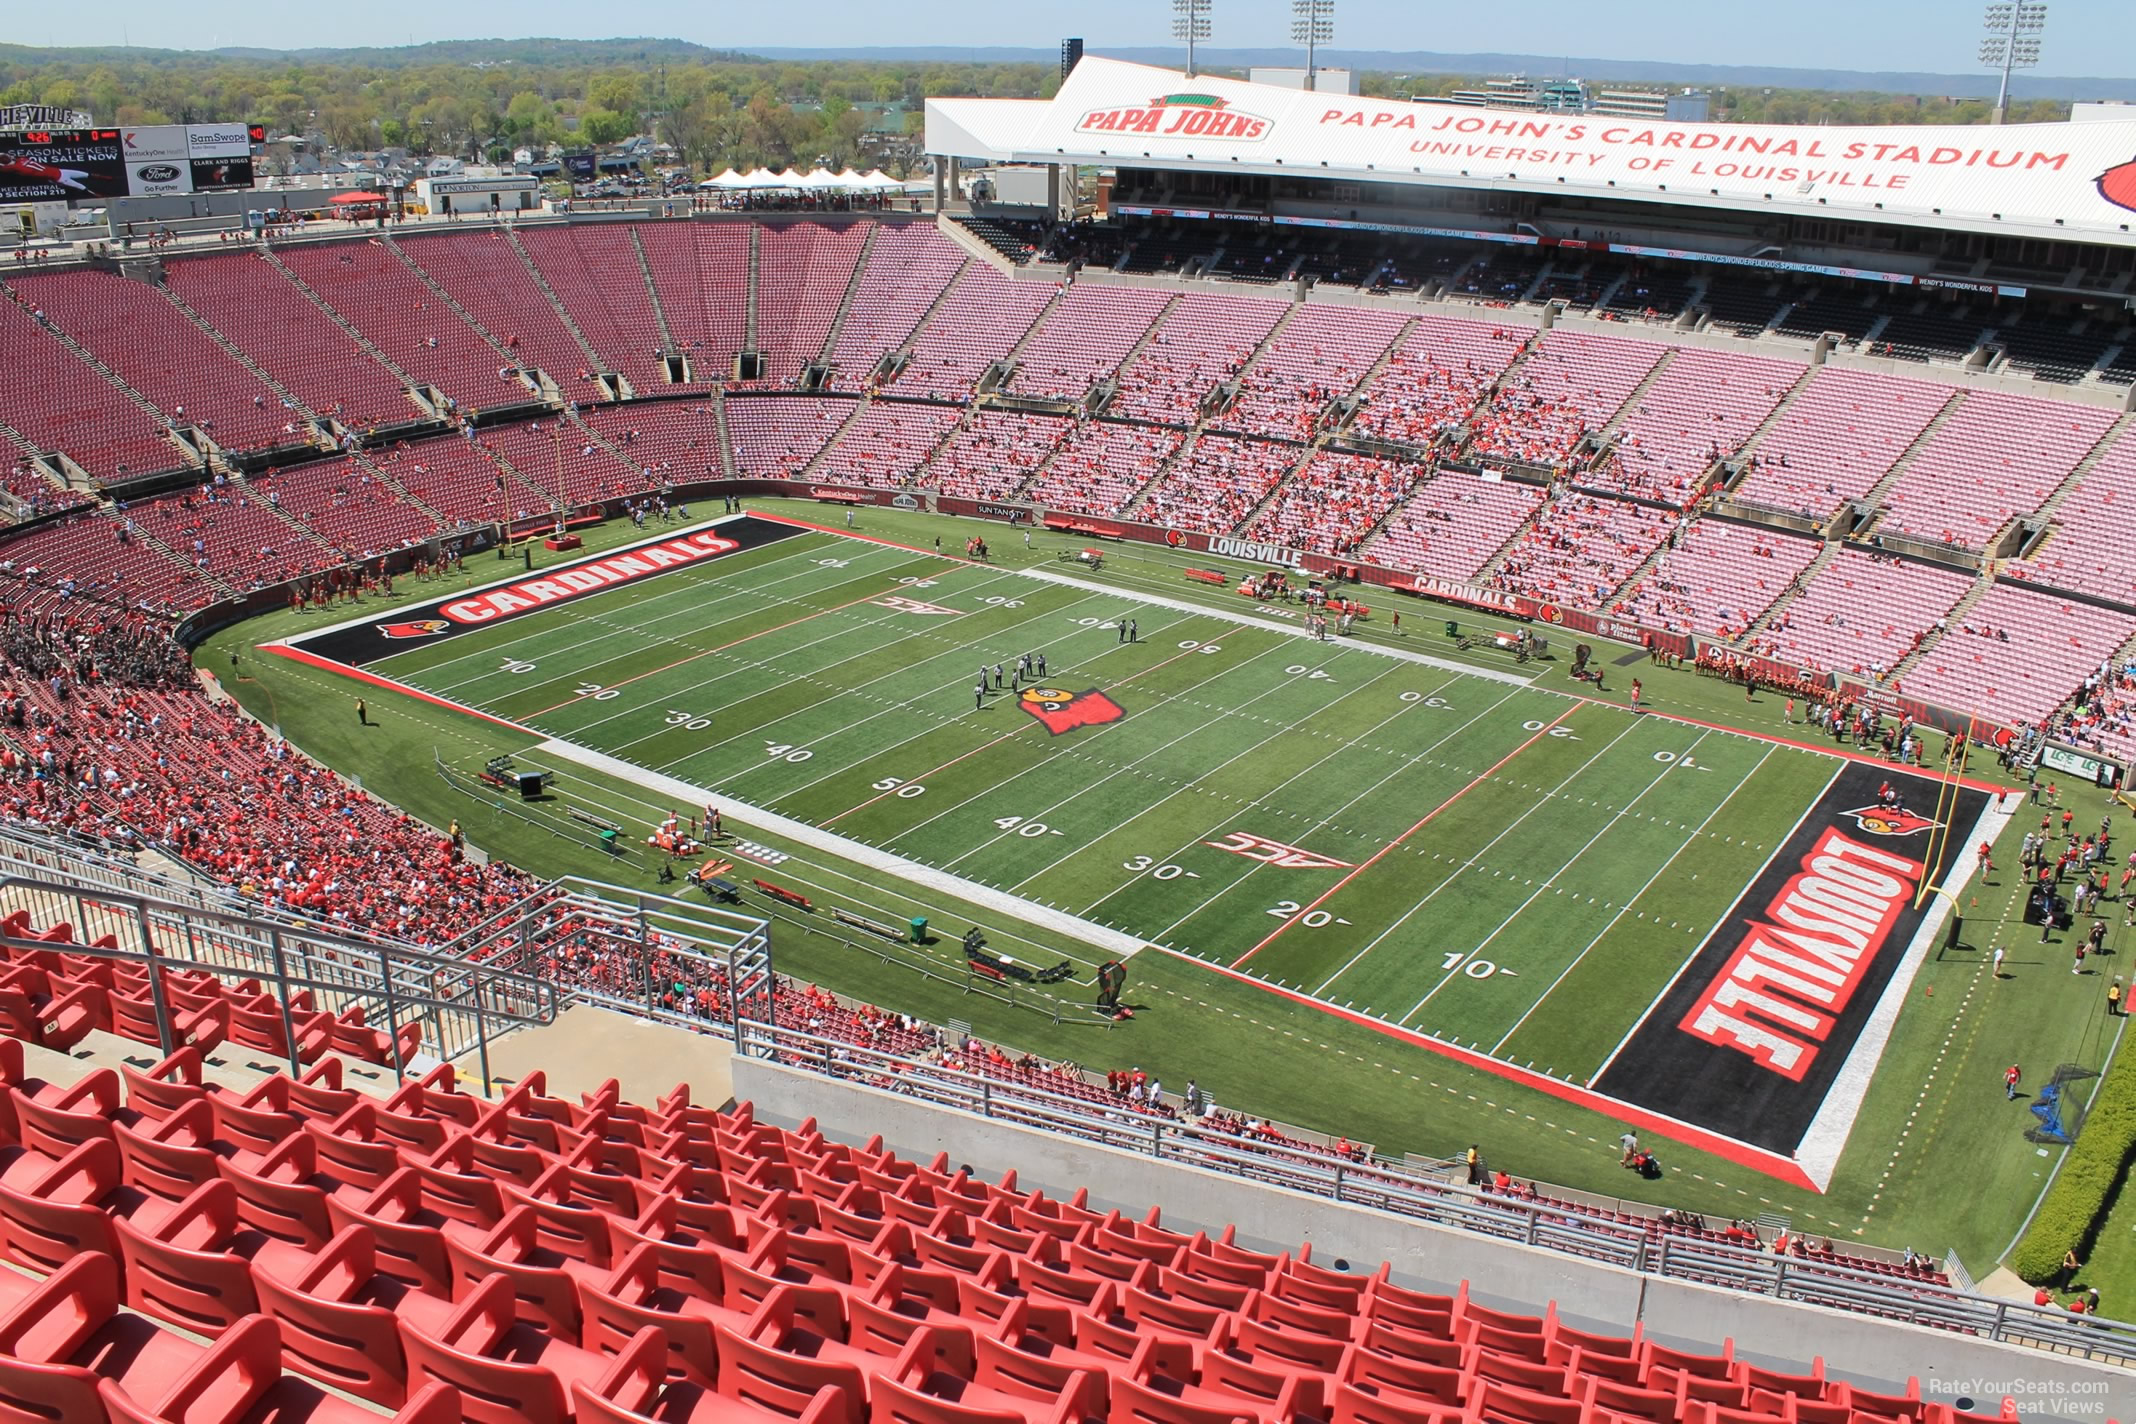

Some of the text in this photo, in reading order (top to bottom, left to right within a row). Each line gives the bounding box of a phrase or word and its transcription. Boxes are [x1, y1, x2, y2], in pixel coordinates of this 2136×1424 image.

[28, 106, 72, 124] VILLE
[1082, 109, 1164, 133] PAPA
[190, 133, 246, 143] SamSwope
[249, 128, 263, 140] 40
[1319, 110, 2069, 170] PAPA JOHN'S CARDINAL STADIUM
[8, 146, 118, 158] SEASON TICKETS
[51, 154, 85, 163] SALE
[88, 153, 118, 161] NOW
[124, 150, 166, 158] KentuckyOne
[1410, 140, 1911, 189] UNIVERSITY OF LOUISVILLE
[146, 167, 173, 180] Ford
[5, 190, 46, 198] SECTION
[20, 184, 60, 192] CENTRAL
[156, 184, 178, 192] Further
[448, 184, 480, 192] NORTON
[1234, 214, 1258, 222] WONDERFUL
[1725, 256, 1763, 267] WONDERFUL
[1780, 262, 1804, 272] SPRING
[1806, 265, 1826, 274] GAME
[1919, 278, 1992, 293] WENDY'S WONDERFUL KIDS
[979, 506, 992, 514] SUN
[1008, 510, 1025, 518] CTY
[1208, 536, 1302, 567] LOUISVILLE
[446, 531, 735, 620] CARDINALS
[1414, 576, 1517, 610] CARDINALS
[1610, 622, 1638, 634] planet
[1613, 630, 1642, 642] fitness
[1178, 640, 1222, 655] 50
[500, 658, 536, 674] 10
[573, 683, 621, 700] 20
[1400, 690, 1448, 708] 30
[1864, 690, 1897, 704] Marriott
[664, 711, 712, 730] 30
[1522, 720, 1576, 738] 20
[764, 744, 814, 763] 40
[871, 777, 926, 798] 50
[993, 816, 1048, 838] 40
[1123, 856, 1184, 881] 30
[1265, 901, 1332, 928] 20
[1692, 834, 1913, 1070] LOUISVILLE
[1441, 952, 1497, 980] 10
[48, 1023, 56, 1031] M
